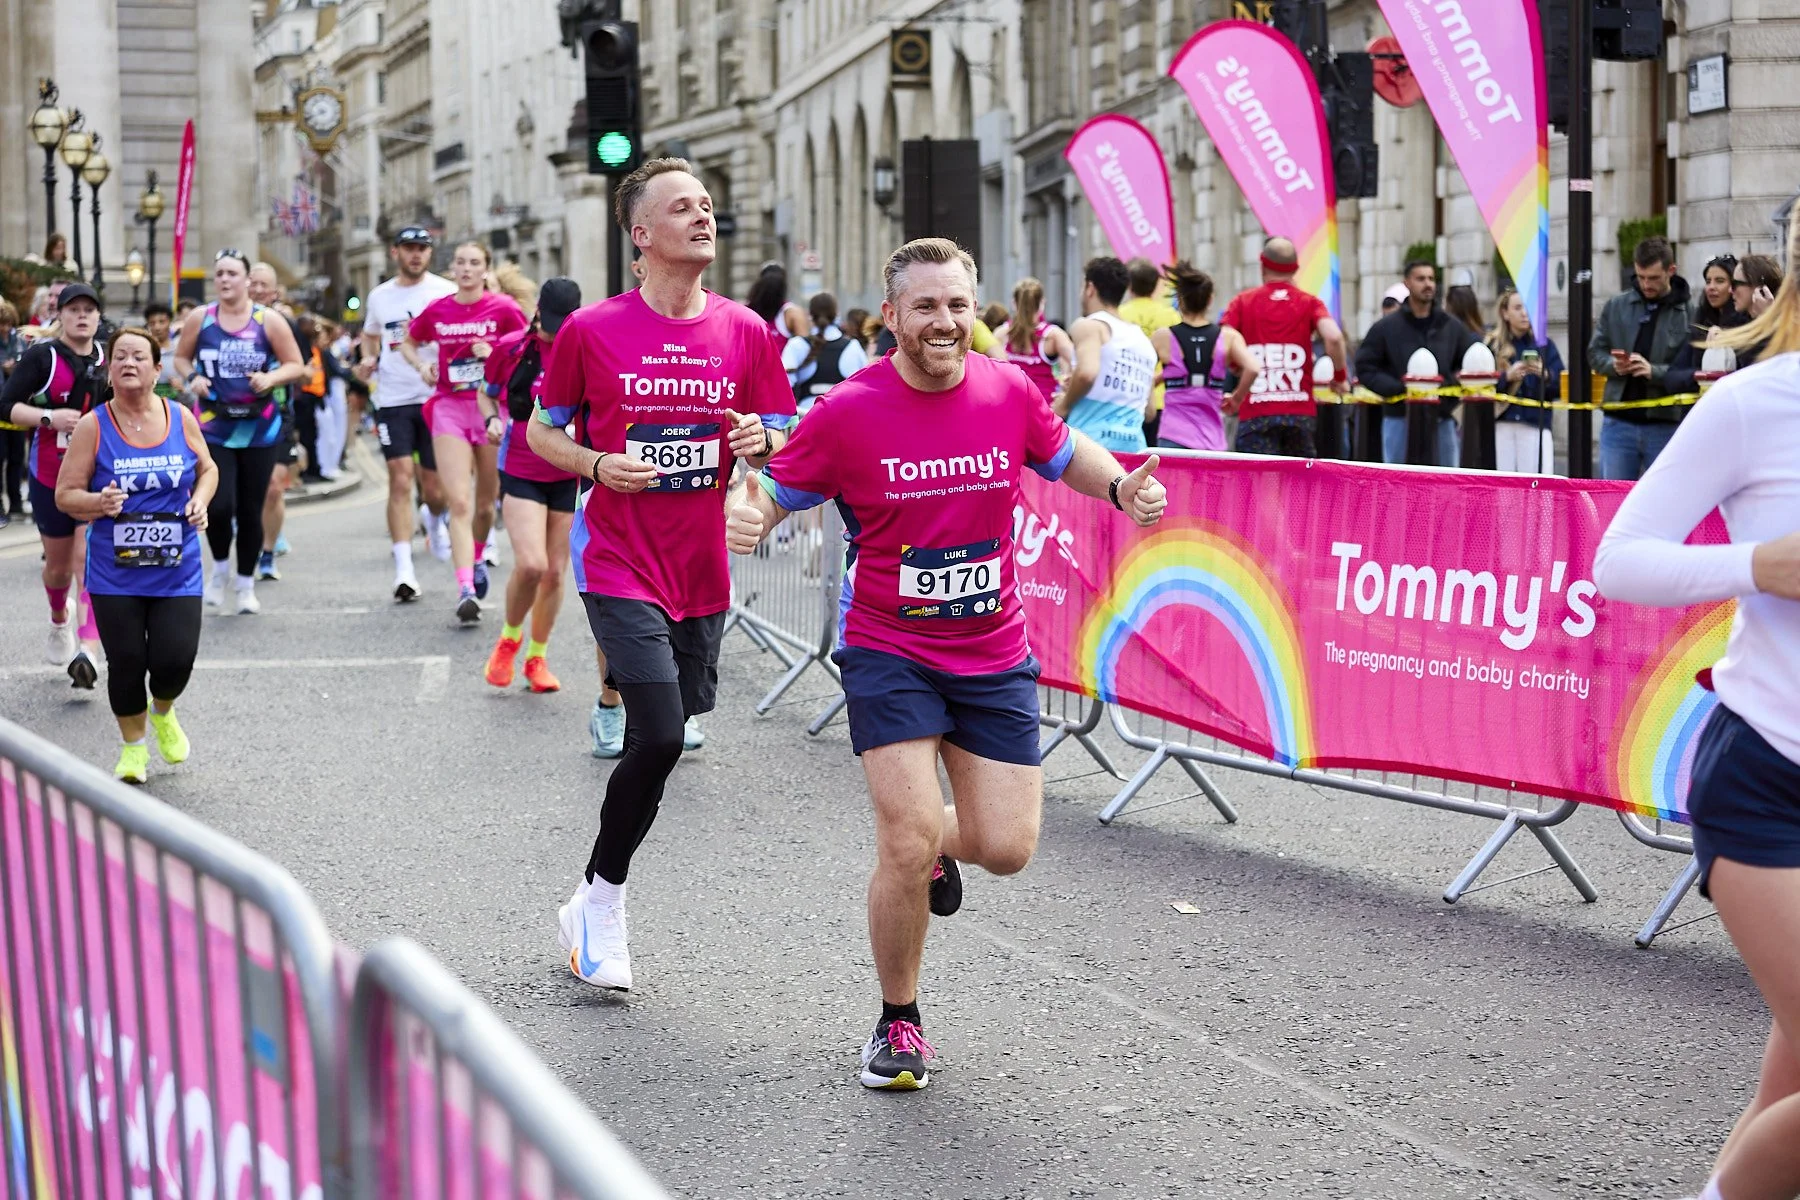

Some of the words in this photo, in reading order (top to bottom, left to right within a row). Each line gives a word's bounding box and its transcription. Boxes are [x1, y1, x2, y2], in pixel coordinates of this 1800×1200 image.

[434, 319, 497, 336] Tommy's
[663, 344, 687, 353] Nina
[642, 356, 669, 365] Mara
[670, 356, 679, 364] &
[680, 356, 708, 368] Romy
[618, 373, 737, 404] Tommy's
[621, 404, 634, 412] The
[635, 405, 675, 413] pregnancy
[676, 404, 692, 412] and
[693, 405, 713, 415] baby
[661, 428, 691, 436] JOERG
[114, 455, 168, 470] DIABETES
[168, 454, 184, 466] UK
[641, 444, 705, 468] 8681
[880, 447, 1010, 482] Tommy's
[120, 470, 183, 493] KAY
[885, 492, 900, 500] The
[902, 488, 946, 500] pregnancy
[948, 484, 965, 493] and
[966, 481, 988, 492] baby
[124, 526, 173, 543] 2732
[944, 549, 968, 560] LUKE
[916, 564, 990, 595] 9170
[1021, 577, 1068, 606] charity
[1331, 541, 1598, 651] Tommy's
[1325, 640, 1346, 664] The
[1348, 649, 1425, 680] pregnancy
[1428, 656, 1462, 680] and
[1466, 657, 1514, 691] baby
[1518, 664, 1591, 700] charity
